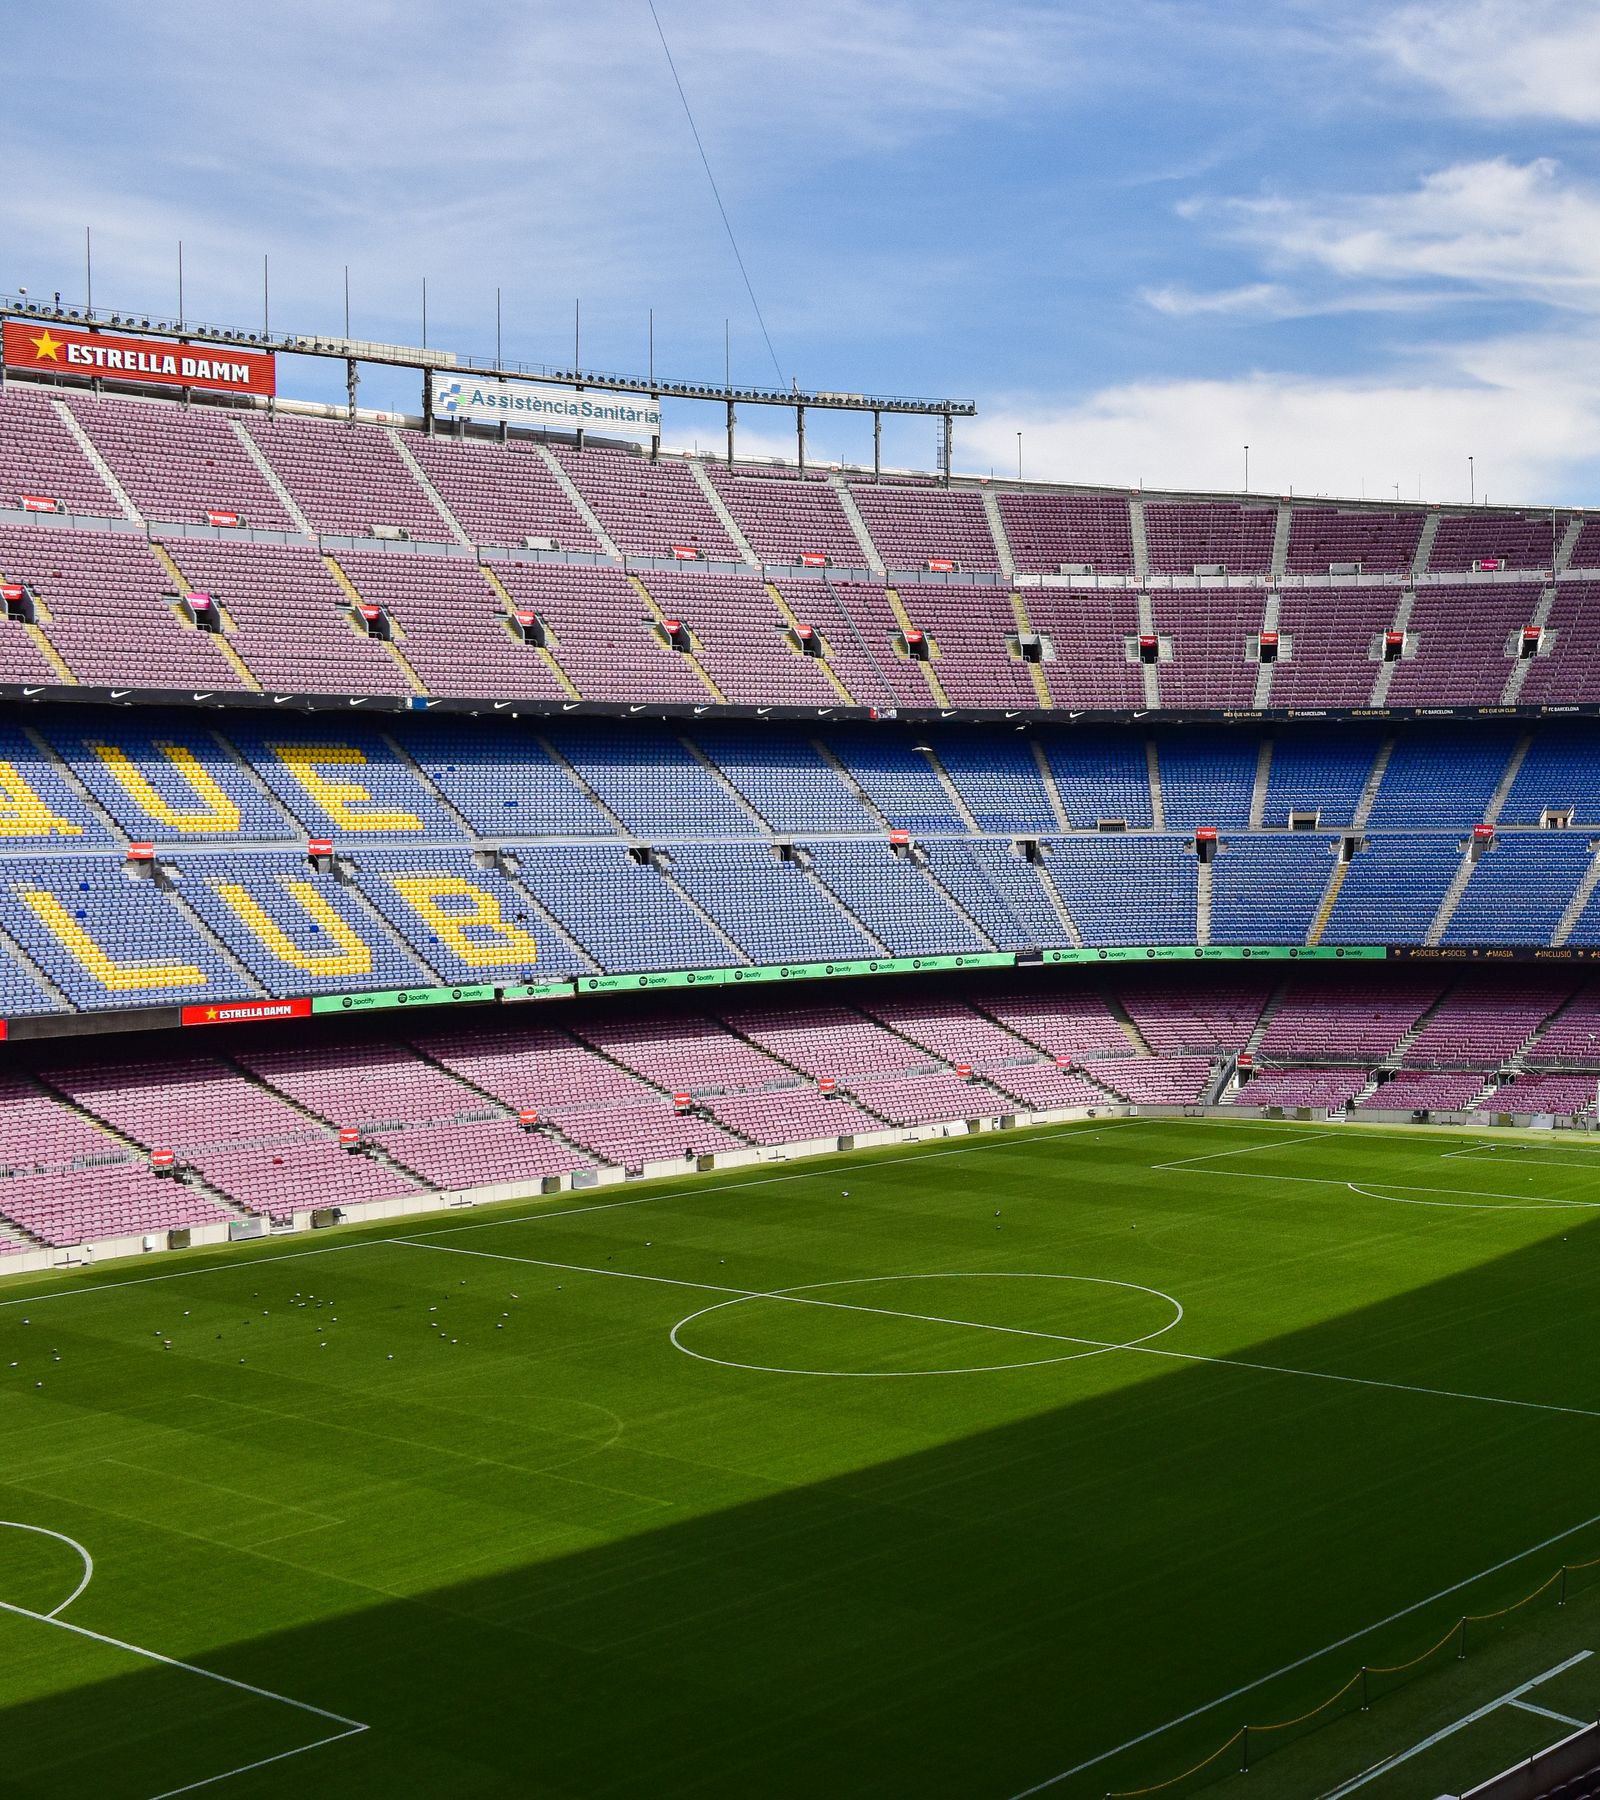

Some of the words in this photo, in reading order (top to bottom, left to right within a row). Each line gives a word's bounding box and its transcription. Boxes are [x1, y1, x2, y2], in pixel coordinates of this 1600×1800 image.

[67, 343, 177, 375] ESTRELLA
[182, 358, 250, 383] DAMM
[471, 390, 578, 416] Assistència
[581, 401, 660, 424] Sanitària
[1061, 952, 1080, 960] Spotify
[1108, 950, 1127, 958] Spotify
[1154, 949, 1174, 957] Spotify
[1202, 949, 1223, 957] Spotify
[1250, 949, 1270, 957] Spotify
[1297, 948, 1317, 957] Spotify
[1343, 948, 1363, 957] Spotify
[920, 959, 938, 968] Spotify
[963, 956, 980, 965] Spotify
[832, 965, 851, 974] Spotify
[877, 961, 895, 970] Spotify
[743, 970, 762, 979] Spotify
[788, 967, 808, 976] Spotify
[648, 976, 667, 985] Spotify
[696, 973, 715, 983] Spotify
[598, 979, 618, 989] Spotify
[408, 993, 430, 1003] Spotify
[462, 989, 483, 999] Spotify
[353, 996, 375, 1006] Spotify
[219, 1007, 262, 1019] ESTRELLA
[263, 1005, 292, 1016] DAMM
